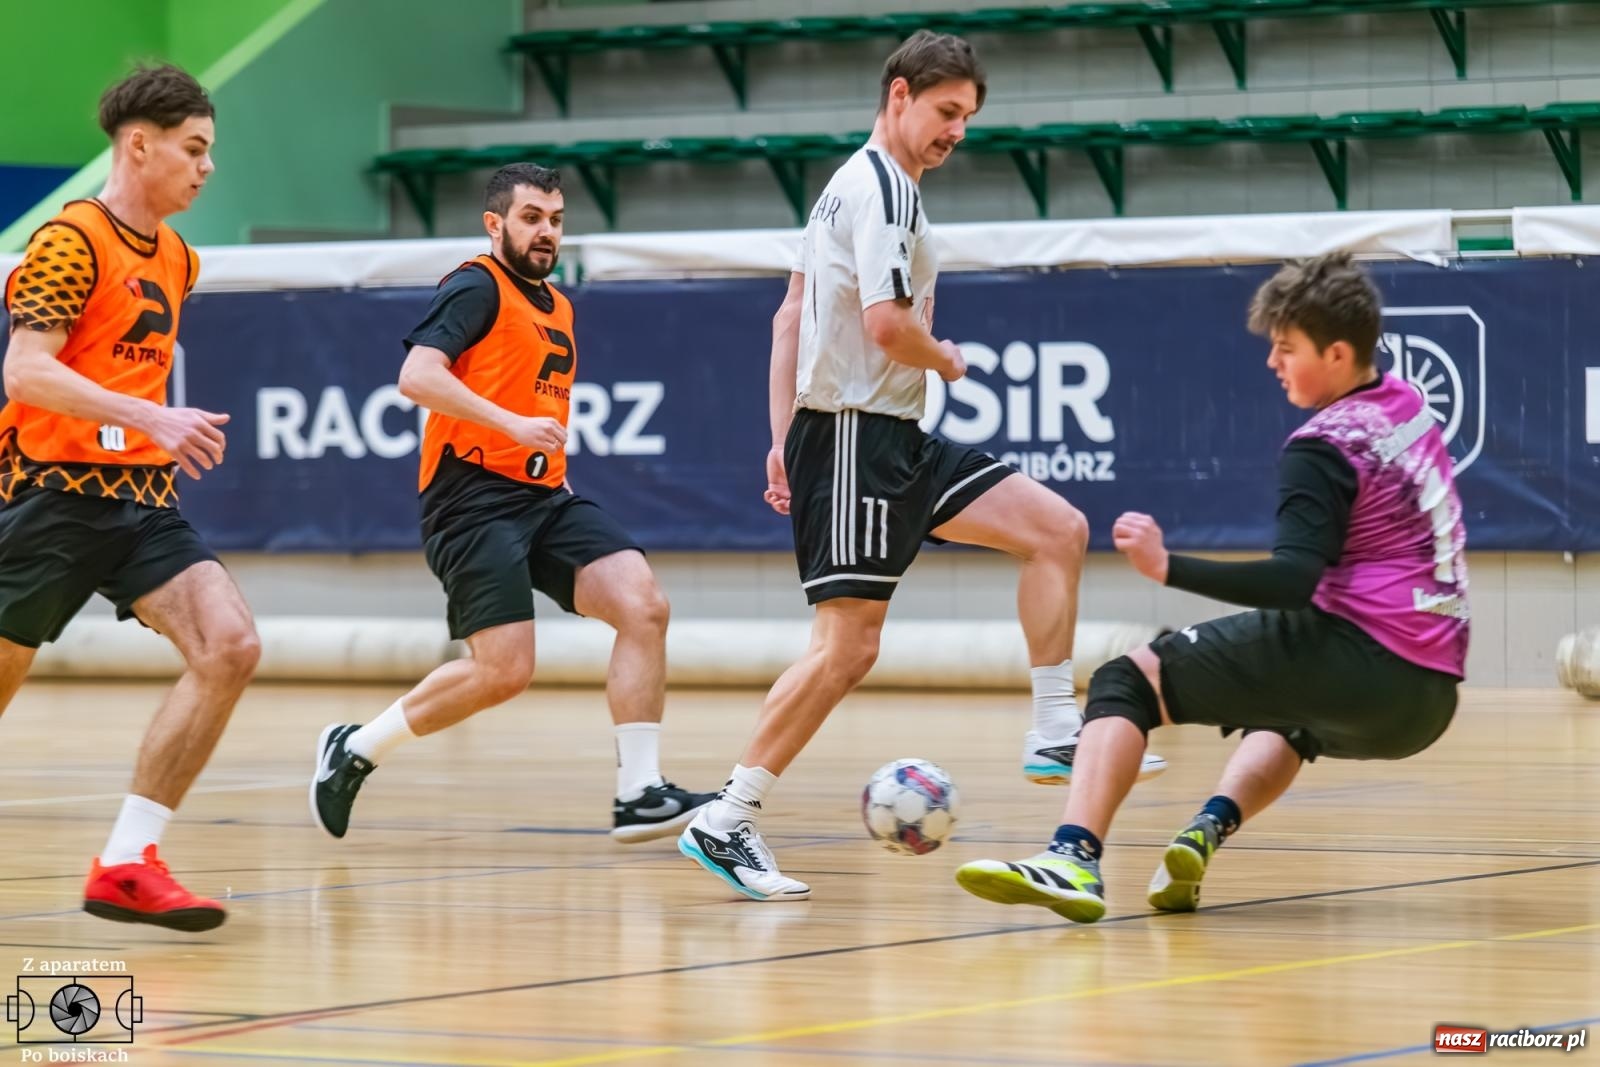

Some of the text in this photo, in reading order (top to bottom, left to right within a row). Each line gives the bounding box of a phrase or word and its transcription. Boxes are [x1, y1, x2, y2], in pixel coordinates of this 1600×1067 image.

[812, 192, 842, 227] AR
[99, 424, 126, 451] 10
[257, 382, 666, 459] RACRZ
[531, 454, 545, 478] 1
[862, 496, 888, 558] 11
